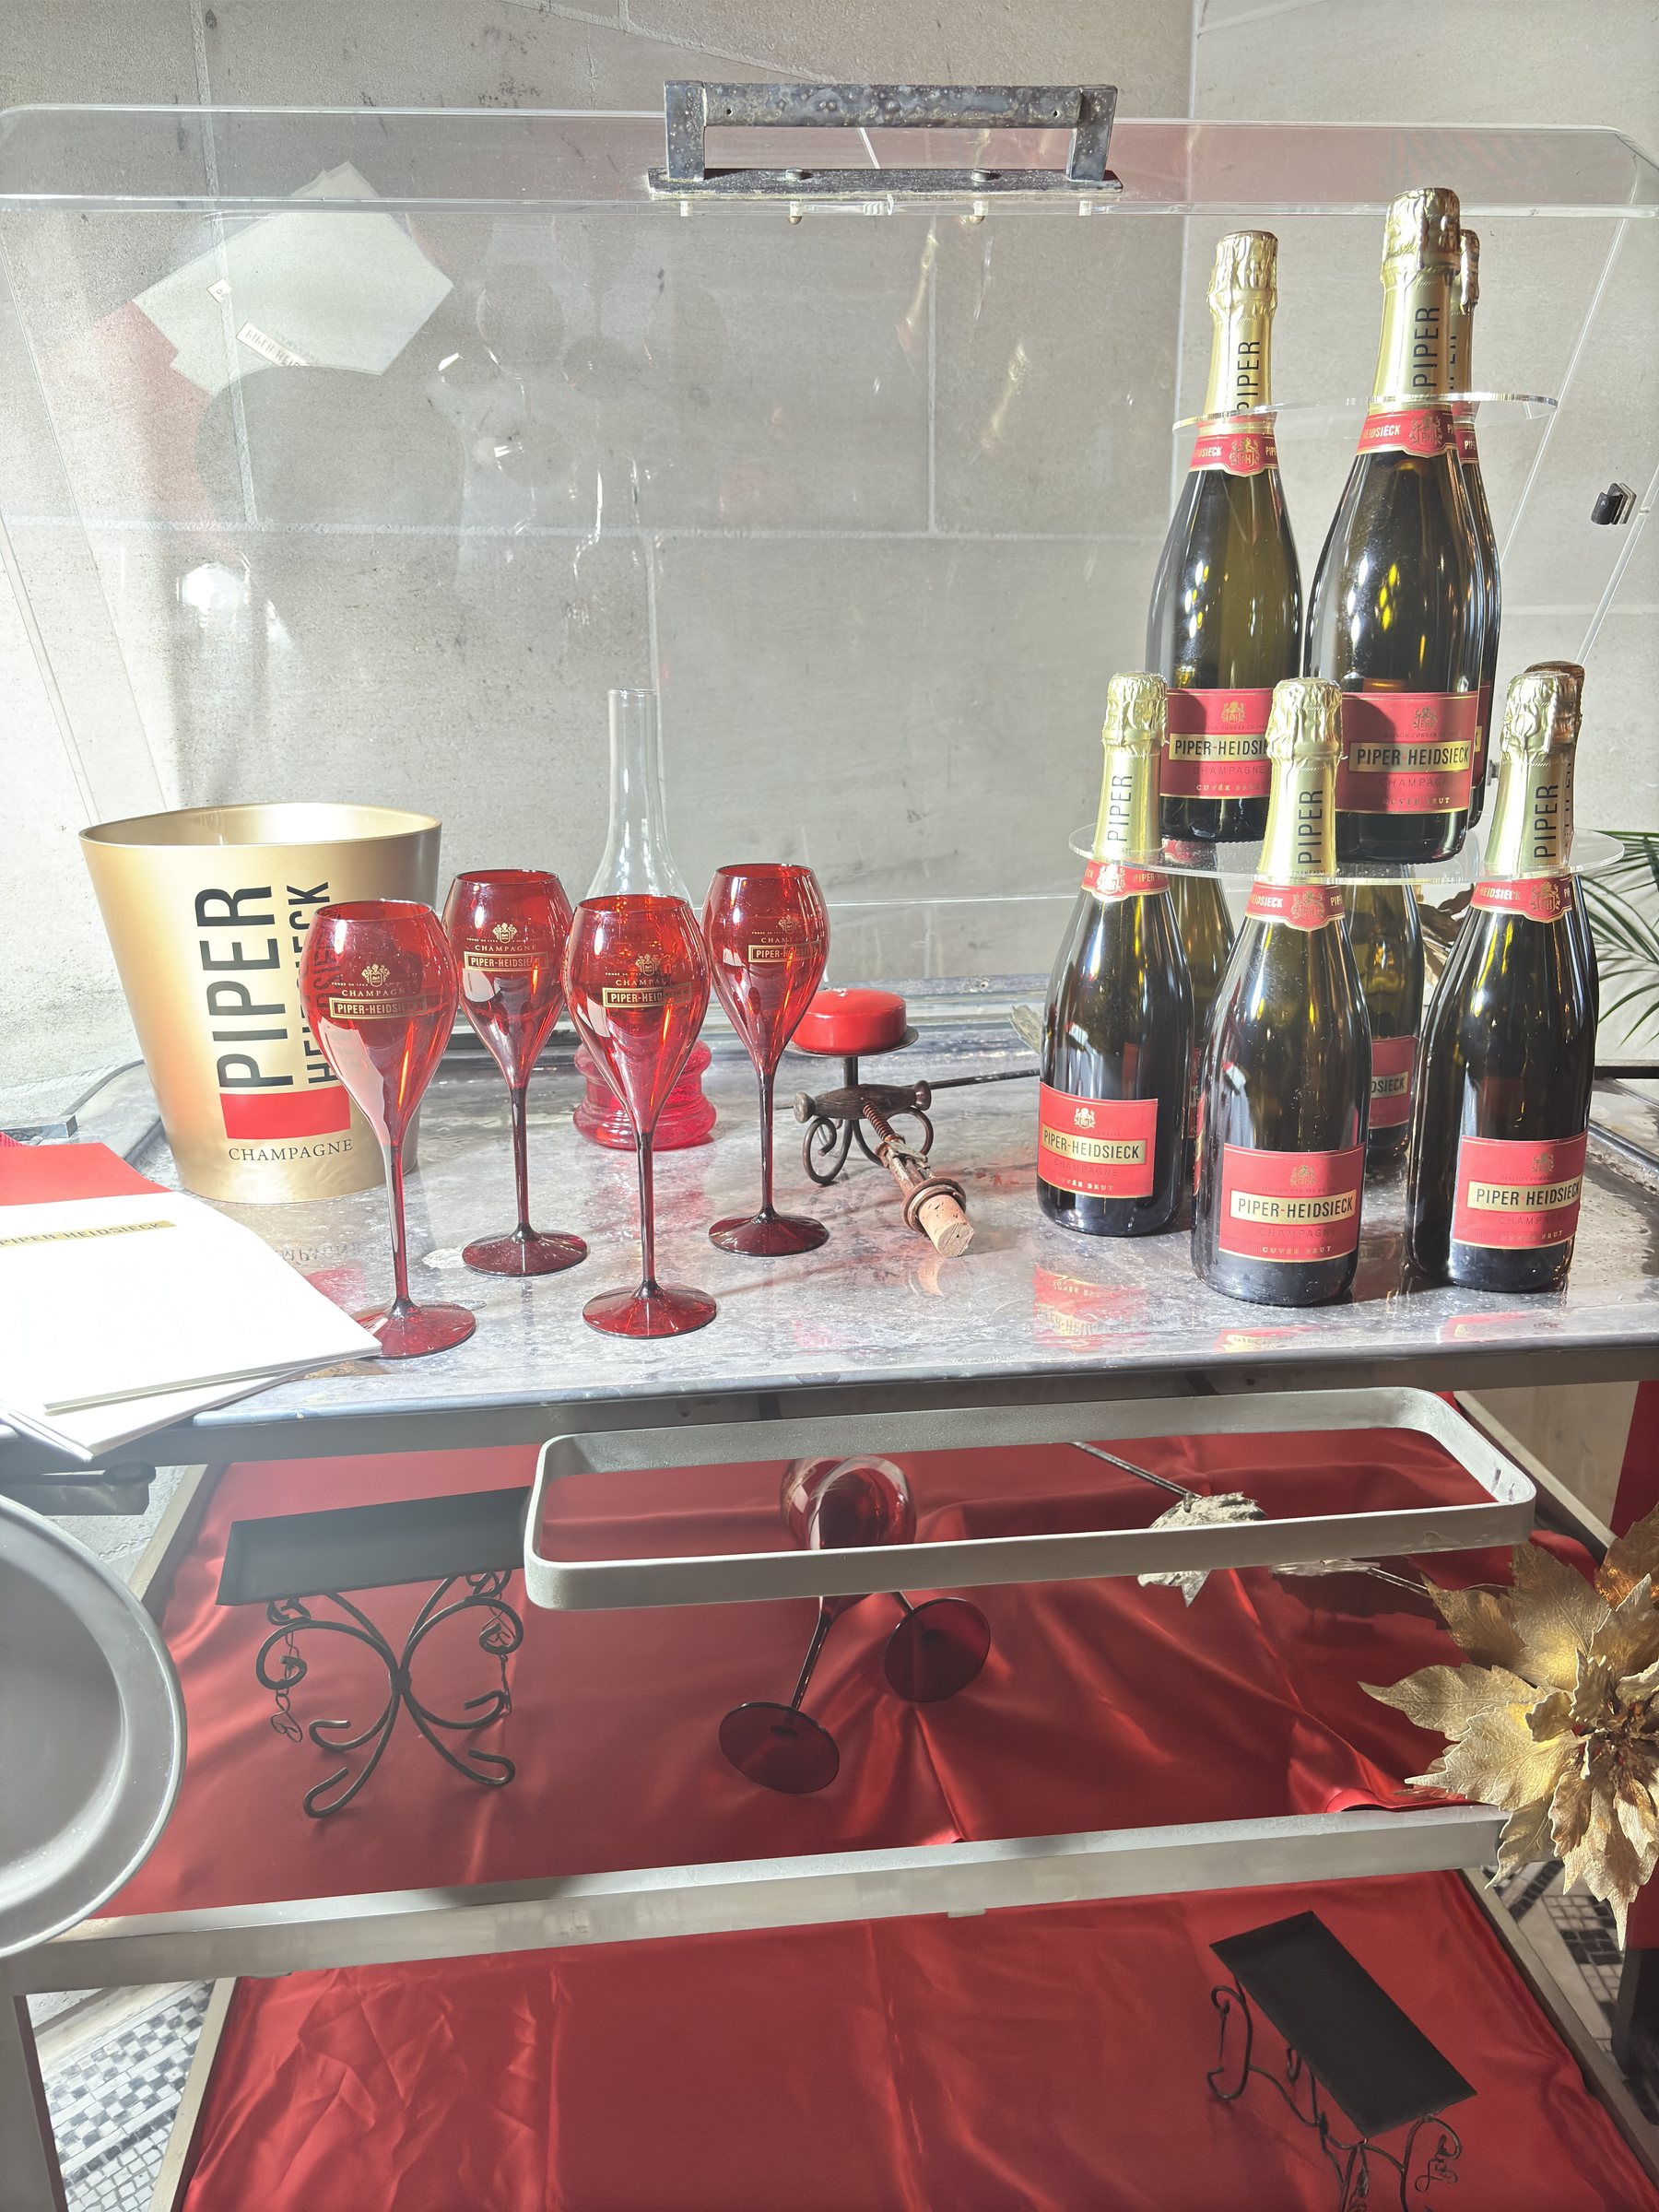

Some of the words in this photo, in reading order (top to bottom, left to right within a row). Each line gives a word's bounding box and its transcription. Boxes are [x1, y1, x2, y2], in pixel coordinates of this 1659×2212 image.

[1413, 307, 1440, 388] PIPER
[1357, 747, 1469, 766] PIPER-HEIDSIECK
[1107, 775, 1133, 842] PIPER
[1534, 784, 1559, 858] PIPER
[1298, 789, 1324, 865] PIPER
[194, 885, 294, 1088] PIPER
[229, 1138, 353, 1162] CHAMPAGNE
[1043, 1129, 1139, 1159] PIPER-HEIDSIECK
[1053, 1158, 1119, 1177] CHAMPAGNE
[1238, 1195, 1353, 1218] PIPER-HEIDSIECK
[1476, 1182, 1581, 1206] PIPER-HEIDSIECK
